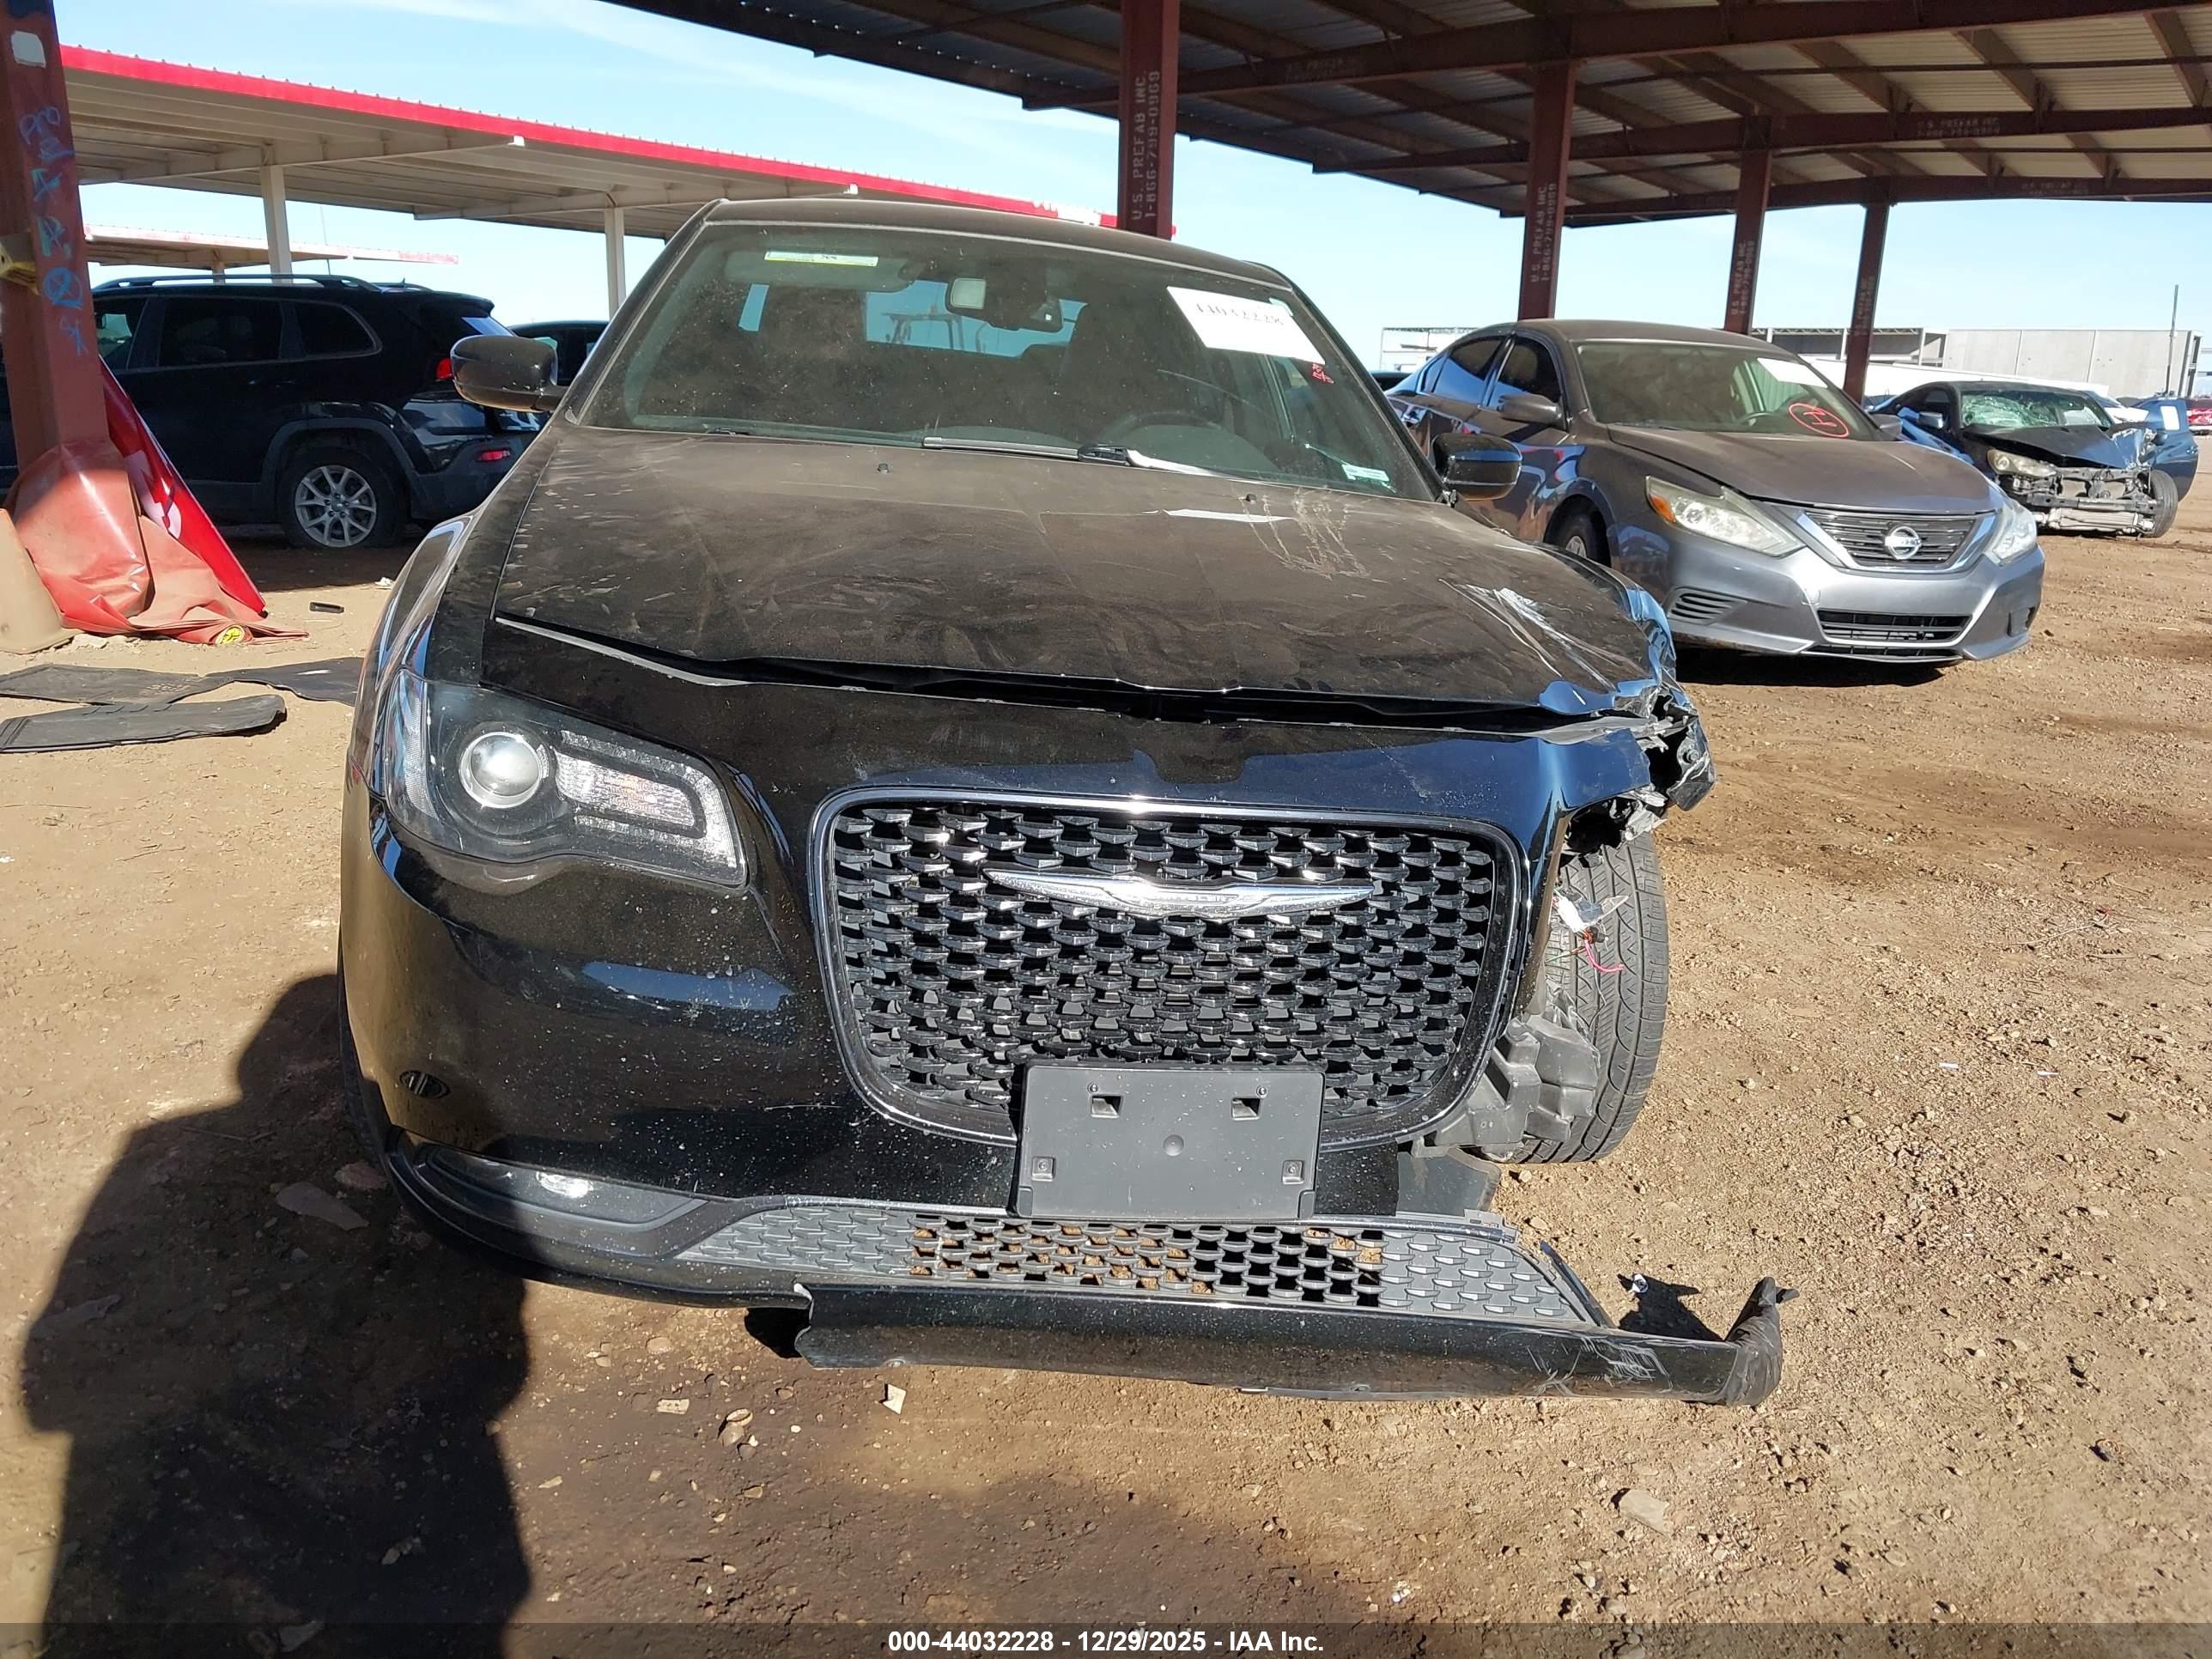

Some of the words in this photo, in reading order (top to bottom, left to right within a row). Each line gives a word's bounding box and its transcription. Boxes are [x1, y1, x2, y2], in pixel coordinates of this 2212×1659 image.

[1134, 70, 1147, 104] INC.
[1133, 112, 1146, 179] PREFAB
[1146, 70, 1160, 218] 1-866-799-0969
[1132, 188, 1144, 221] U.S.
